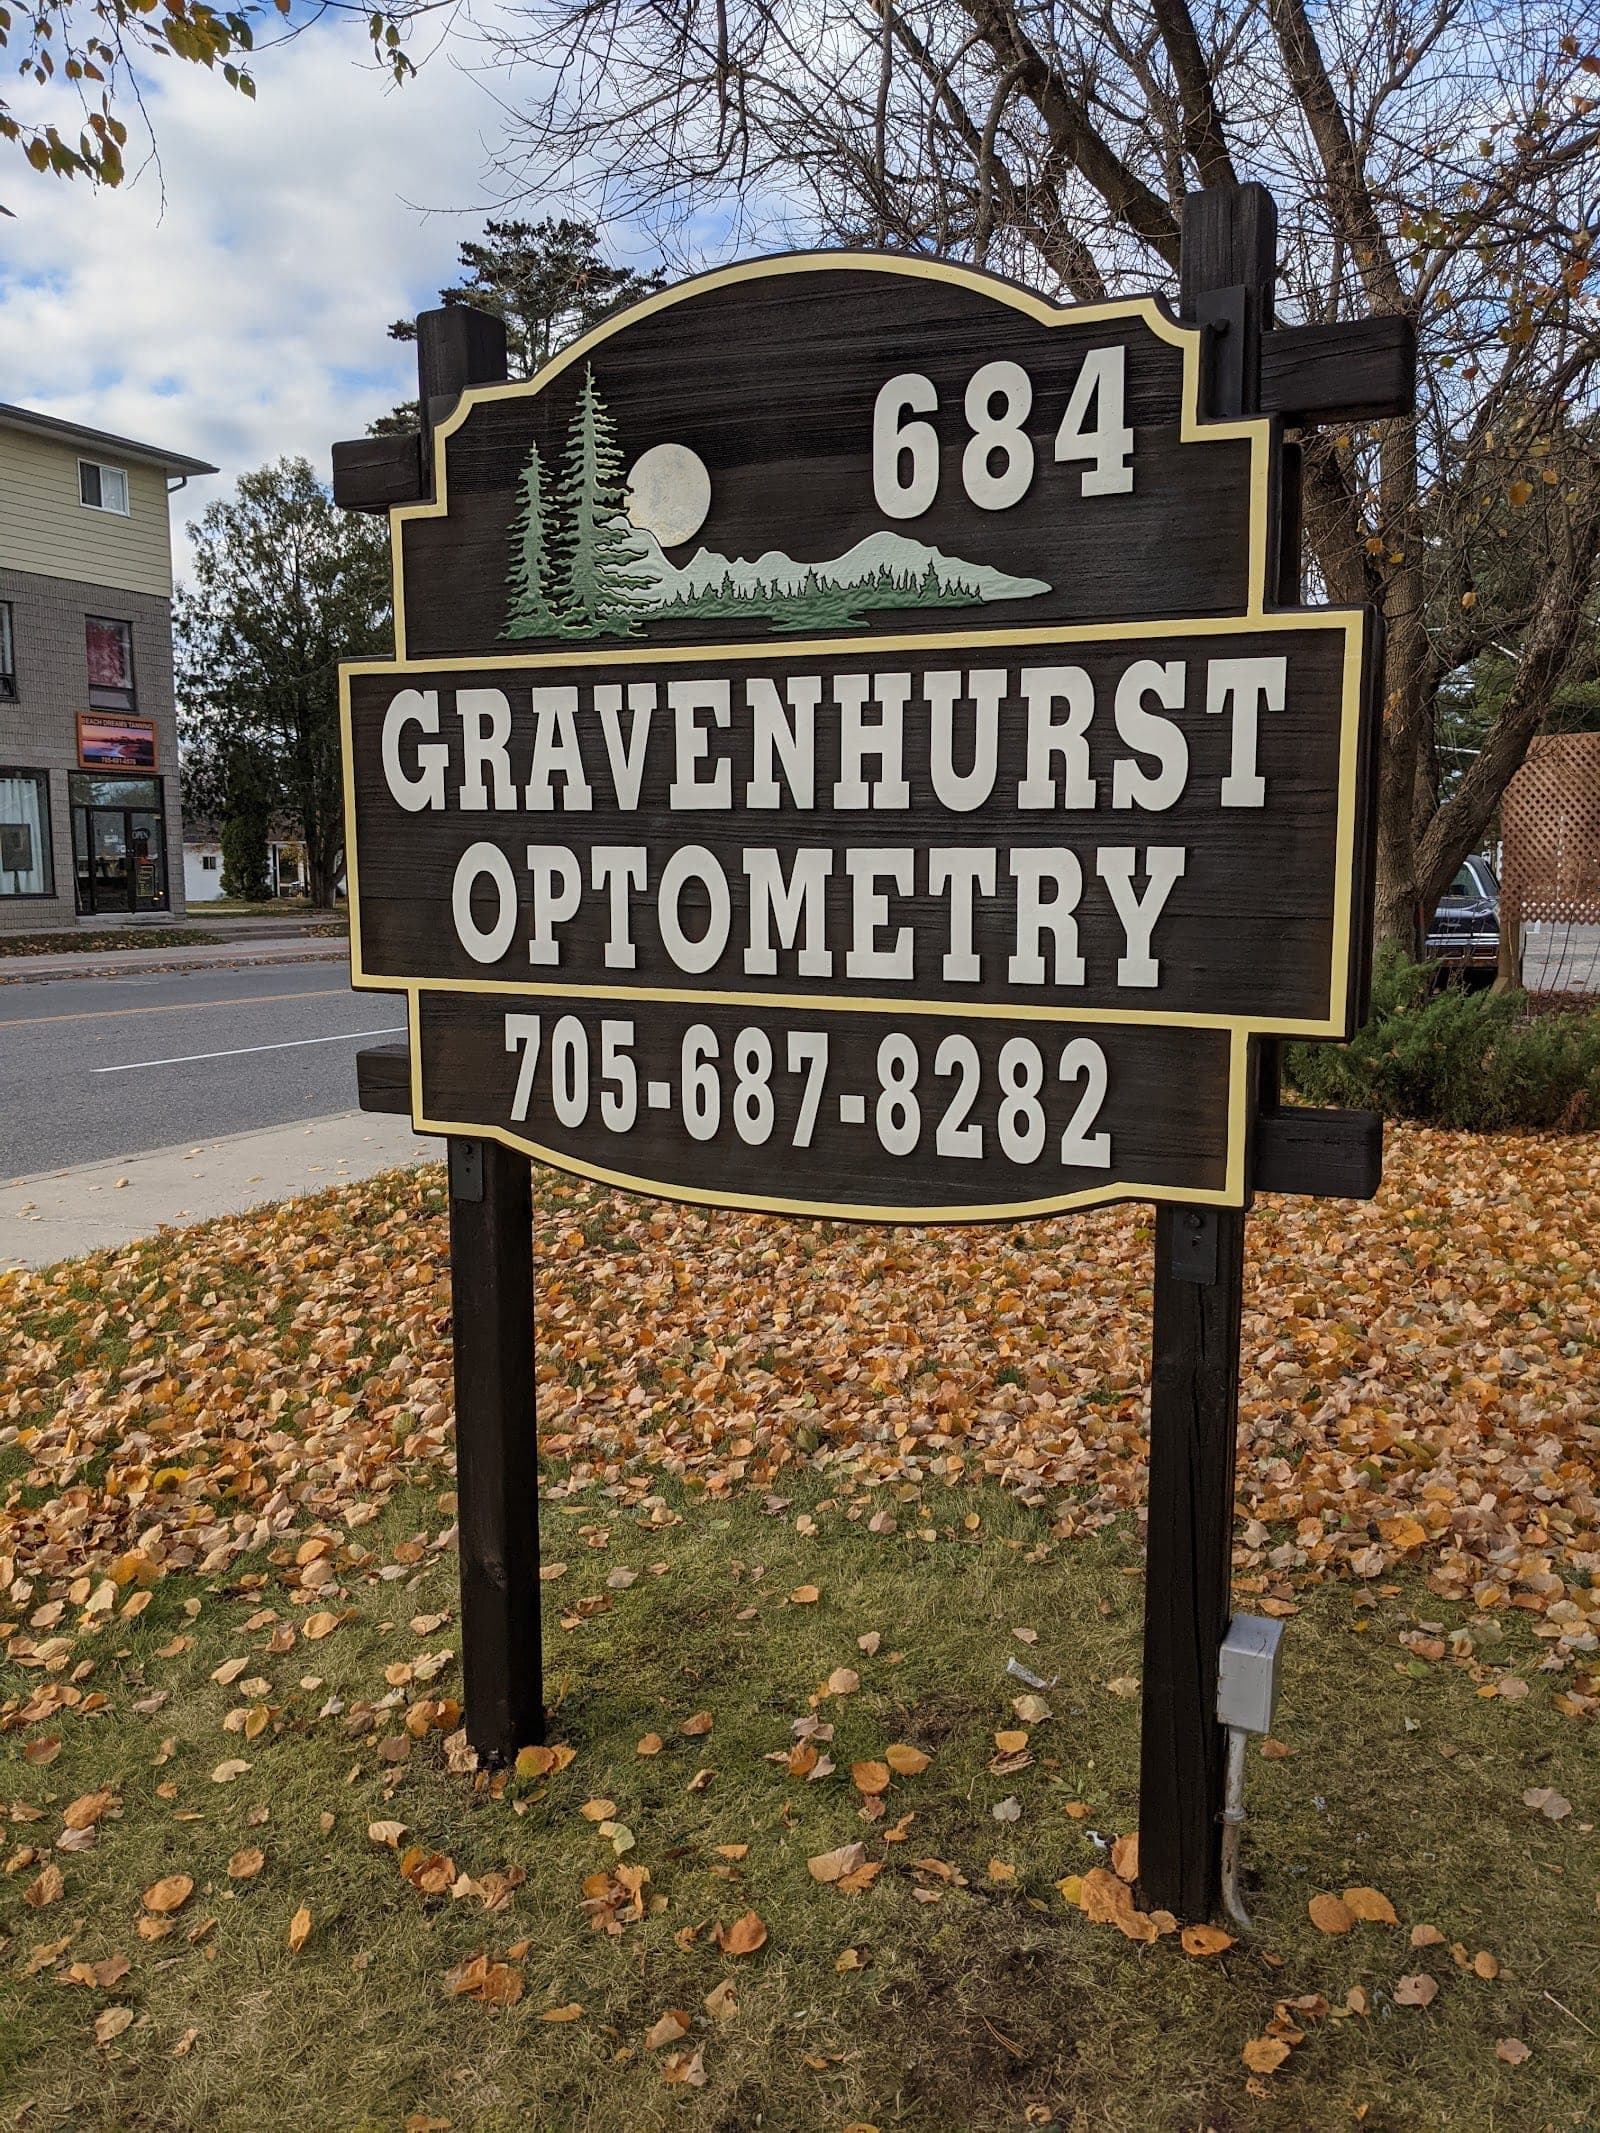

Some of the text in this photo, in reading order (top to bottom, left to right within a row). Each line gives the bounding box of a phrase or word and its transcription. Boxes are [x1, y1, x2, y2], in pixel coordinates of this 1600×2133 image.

[872, 345, 1134, 519] 684
[381, 656, 1287, 812] GRAVENHURST
[132, 830, 149, 840] OPEN
[452, 842, 1186, 988] OPTOMETRY
[504, 1013, 1111, 1169] 705-687-8282
